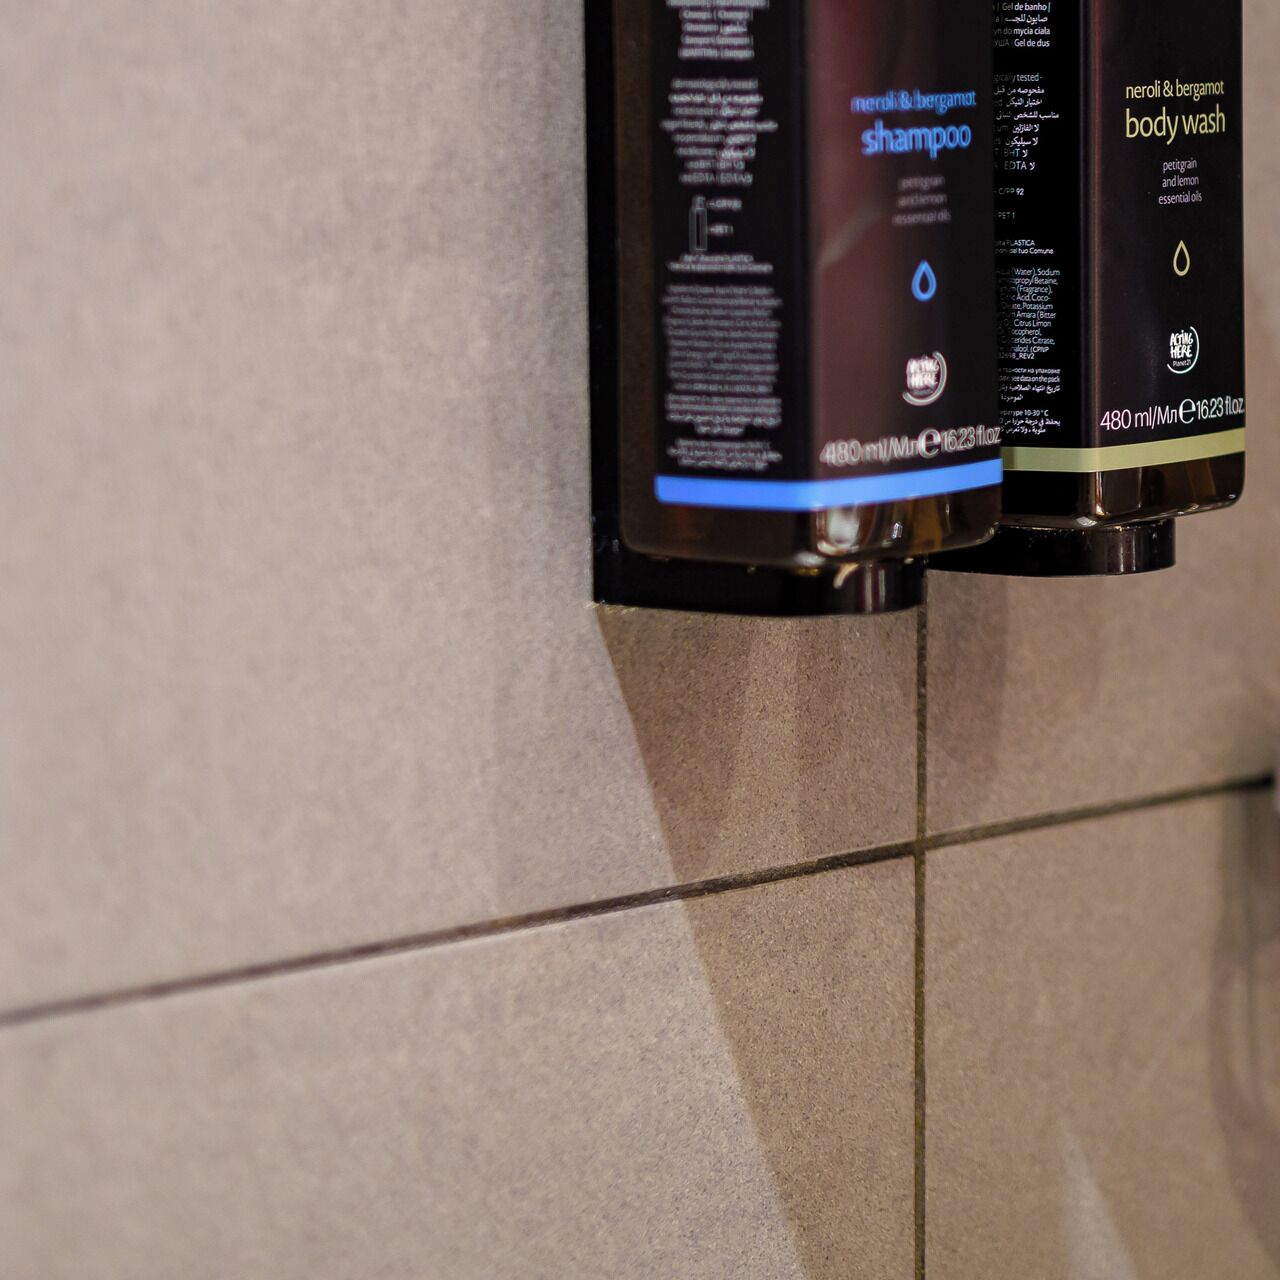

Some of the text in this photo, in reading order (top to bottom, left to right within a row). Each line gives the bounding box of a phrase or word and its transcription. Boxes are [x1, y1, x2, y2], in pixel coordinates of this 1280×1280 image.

[851, 87, 977, 116] neroli & bergamot
[1126, 78, 1225, 102] neroli & bergamot
[1125, 103, 1226, 145] body wash
[861, 119, 972, 160] shampoo
[1162, 157, 1198, 174] petitgrain
[1161, 175, 1199, 188] and lemon
[1158, 190, 1203, 205] essential oils
[1170, 344, 1193, 359] HERE
[1100, 409, 1132, 431] 480
[1196, 397, 1224, 421] 16.23
[819, 439, 862, 467] 480
